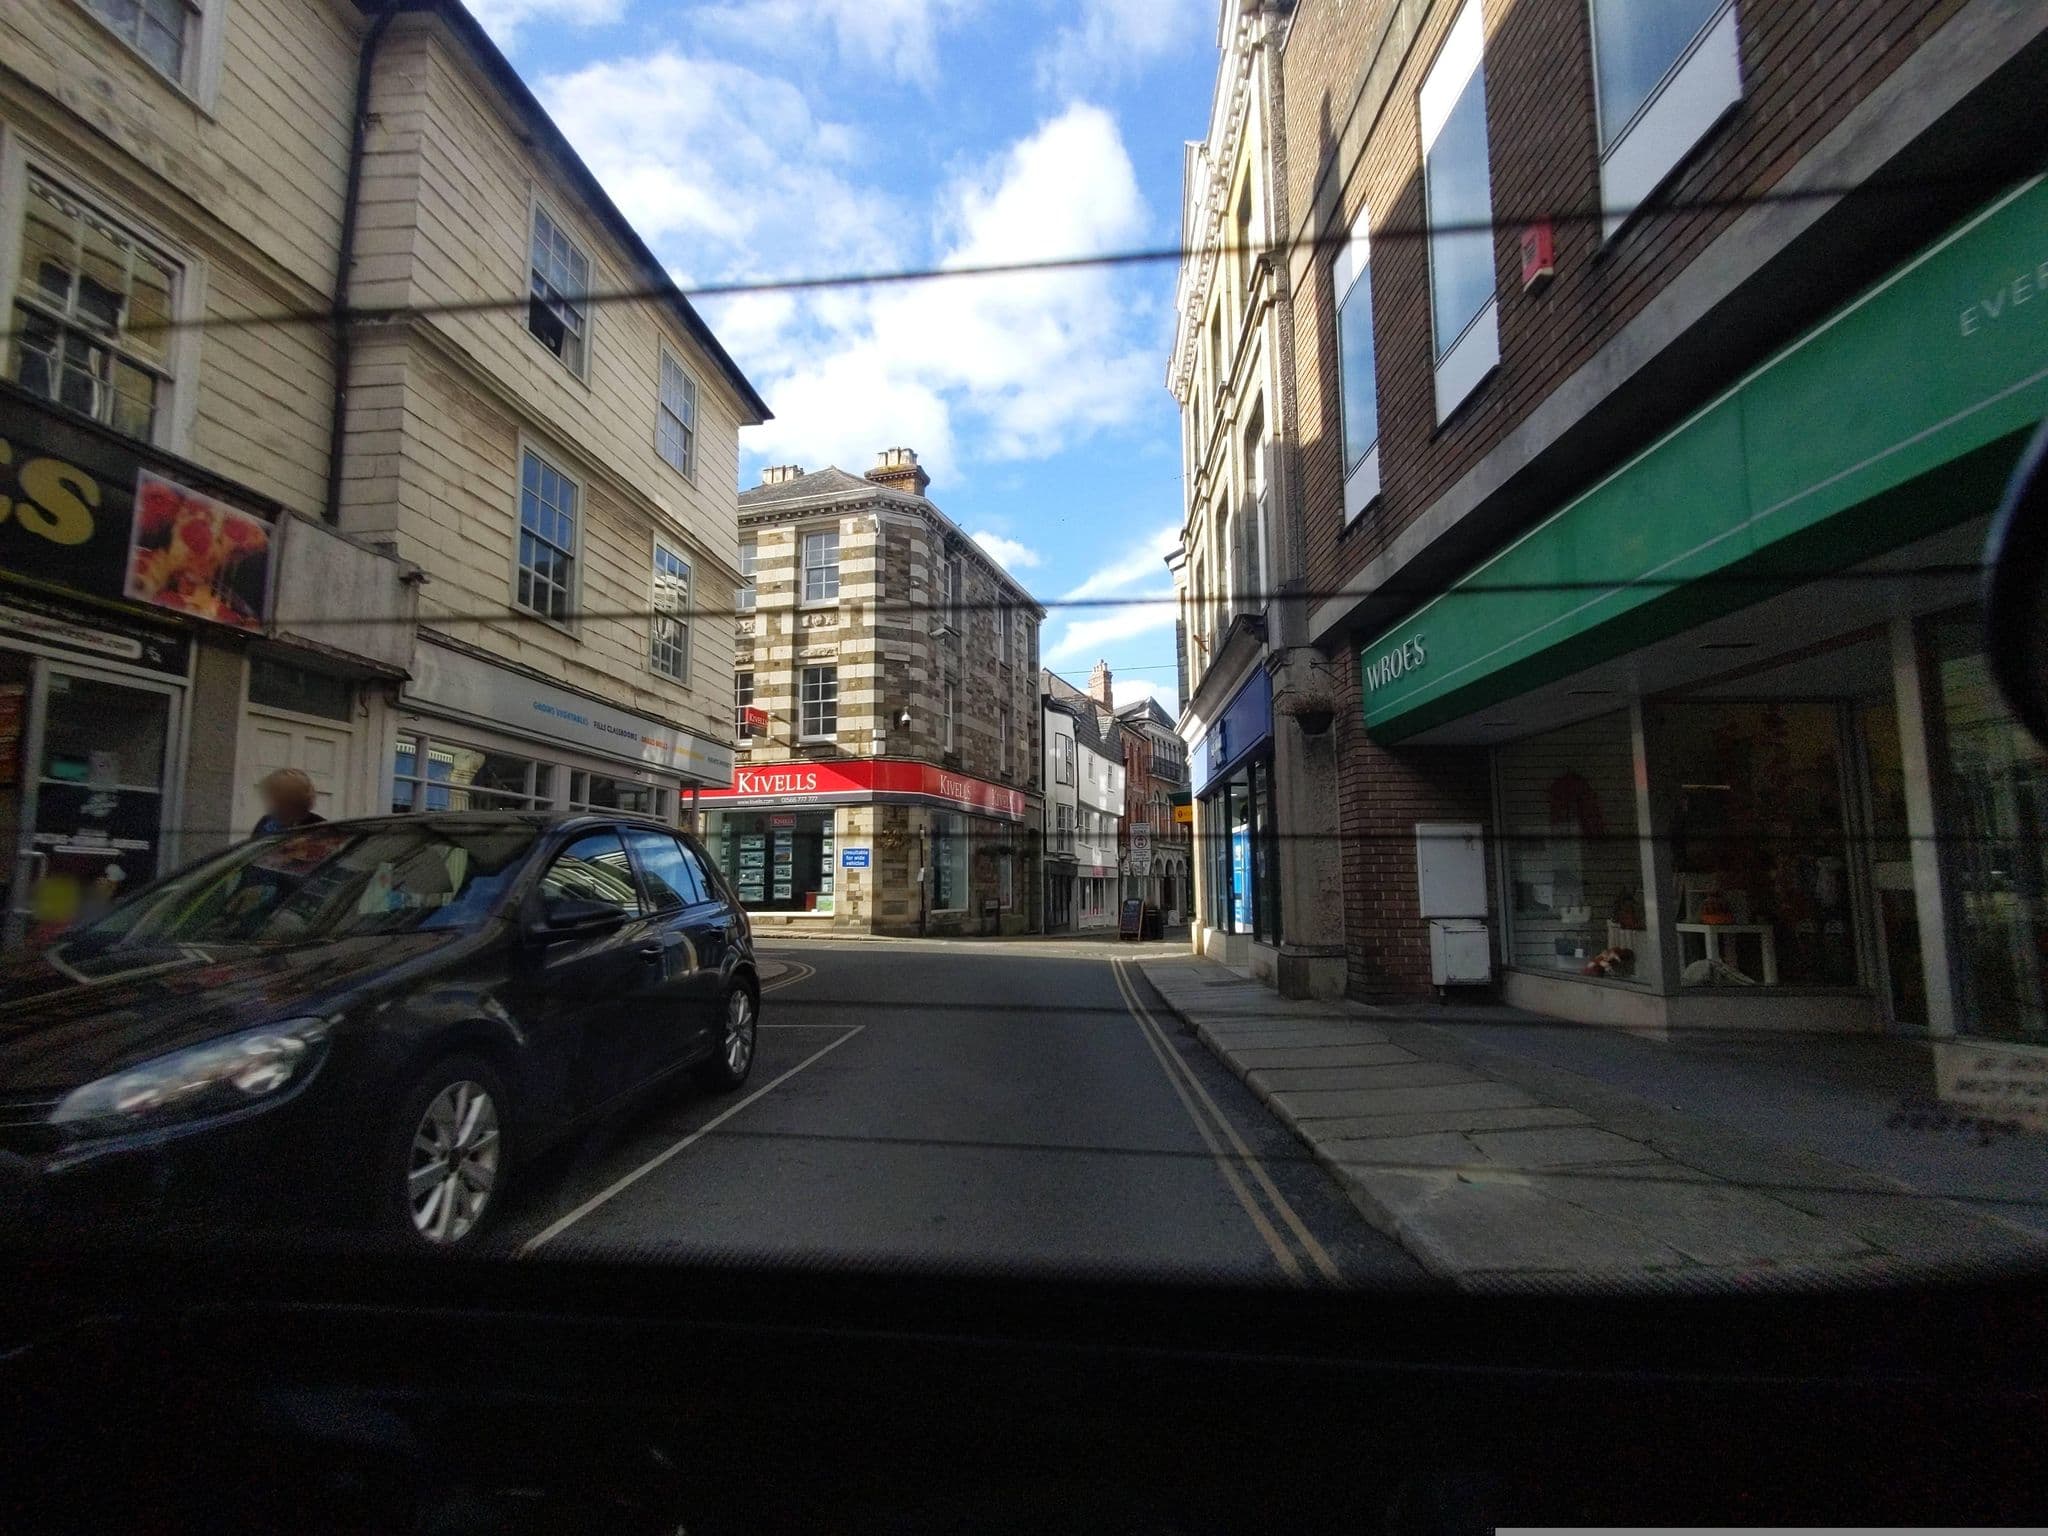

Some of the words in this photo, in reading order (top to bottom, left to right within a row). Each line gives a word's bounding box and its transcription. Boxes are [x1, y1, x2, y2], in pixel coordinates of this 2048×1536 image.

[1366, 633, 1424, 691] WROES
[737, 772, 817, 793] KIVELLS
[940, 775, 971, 800] KIVELLS
